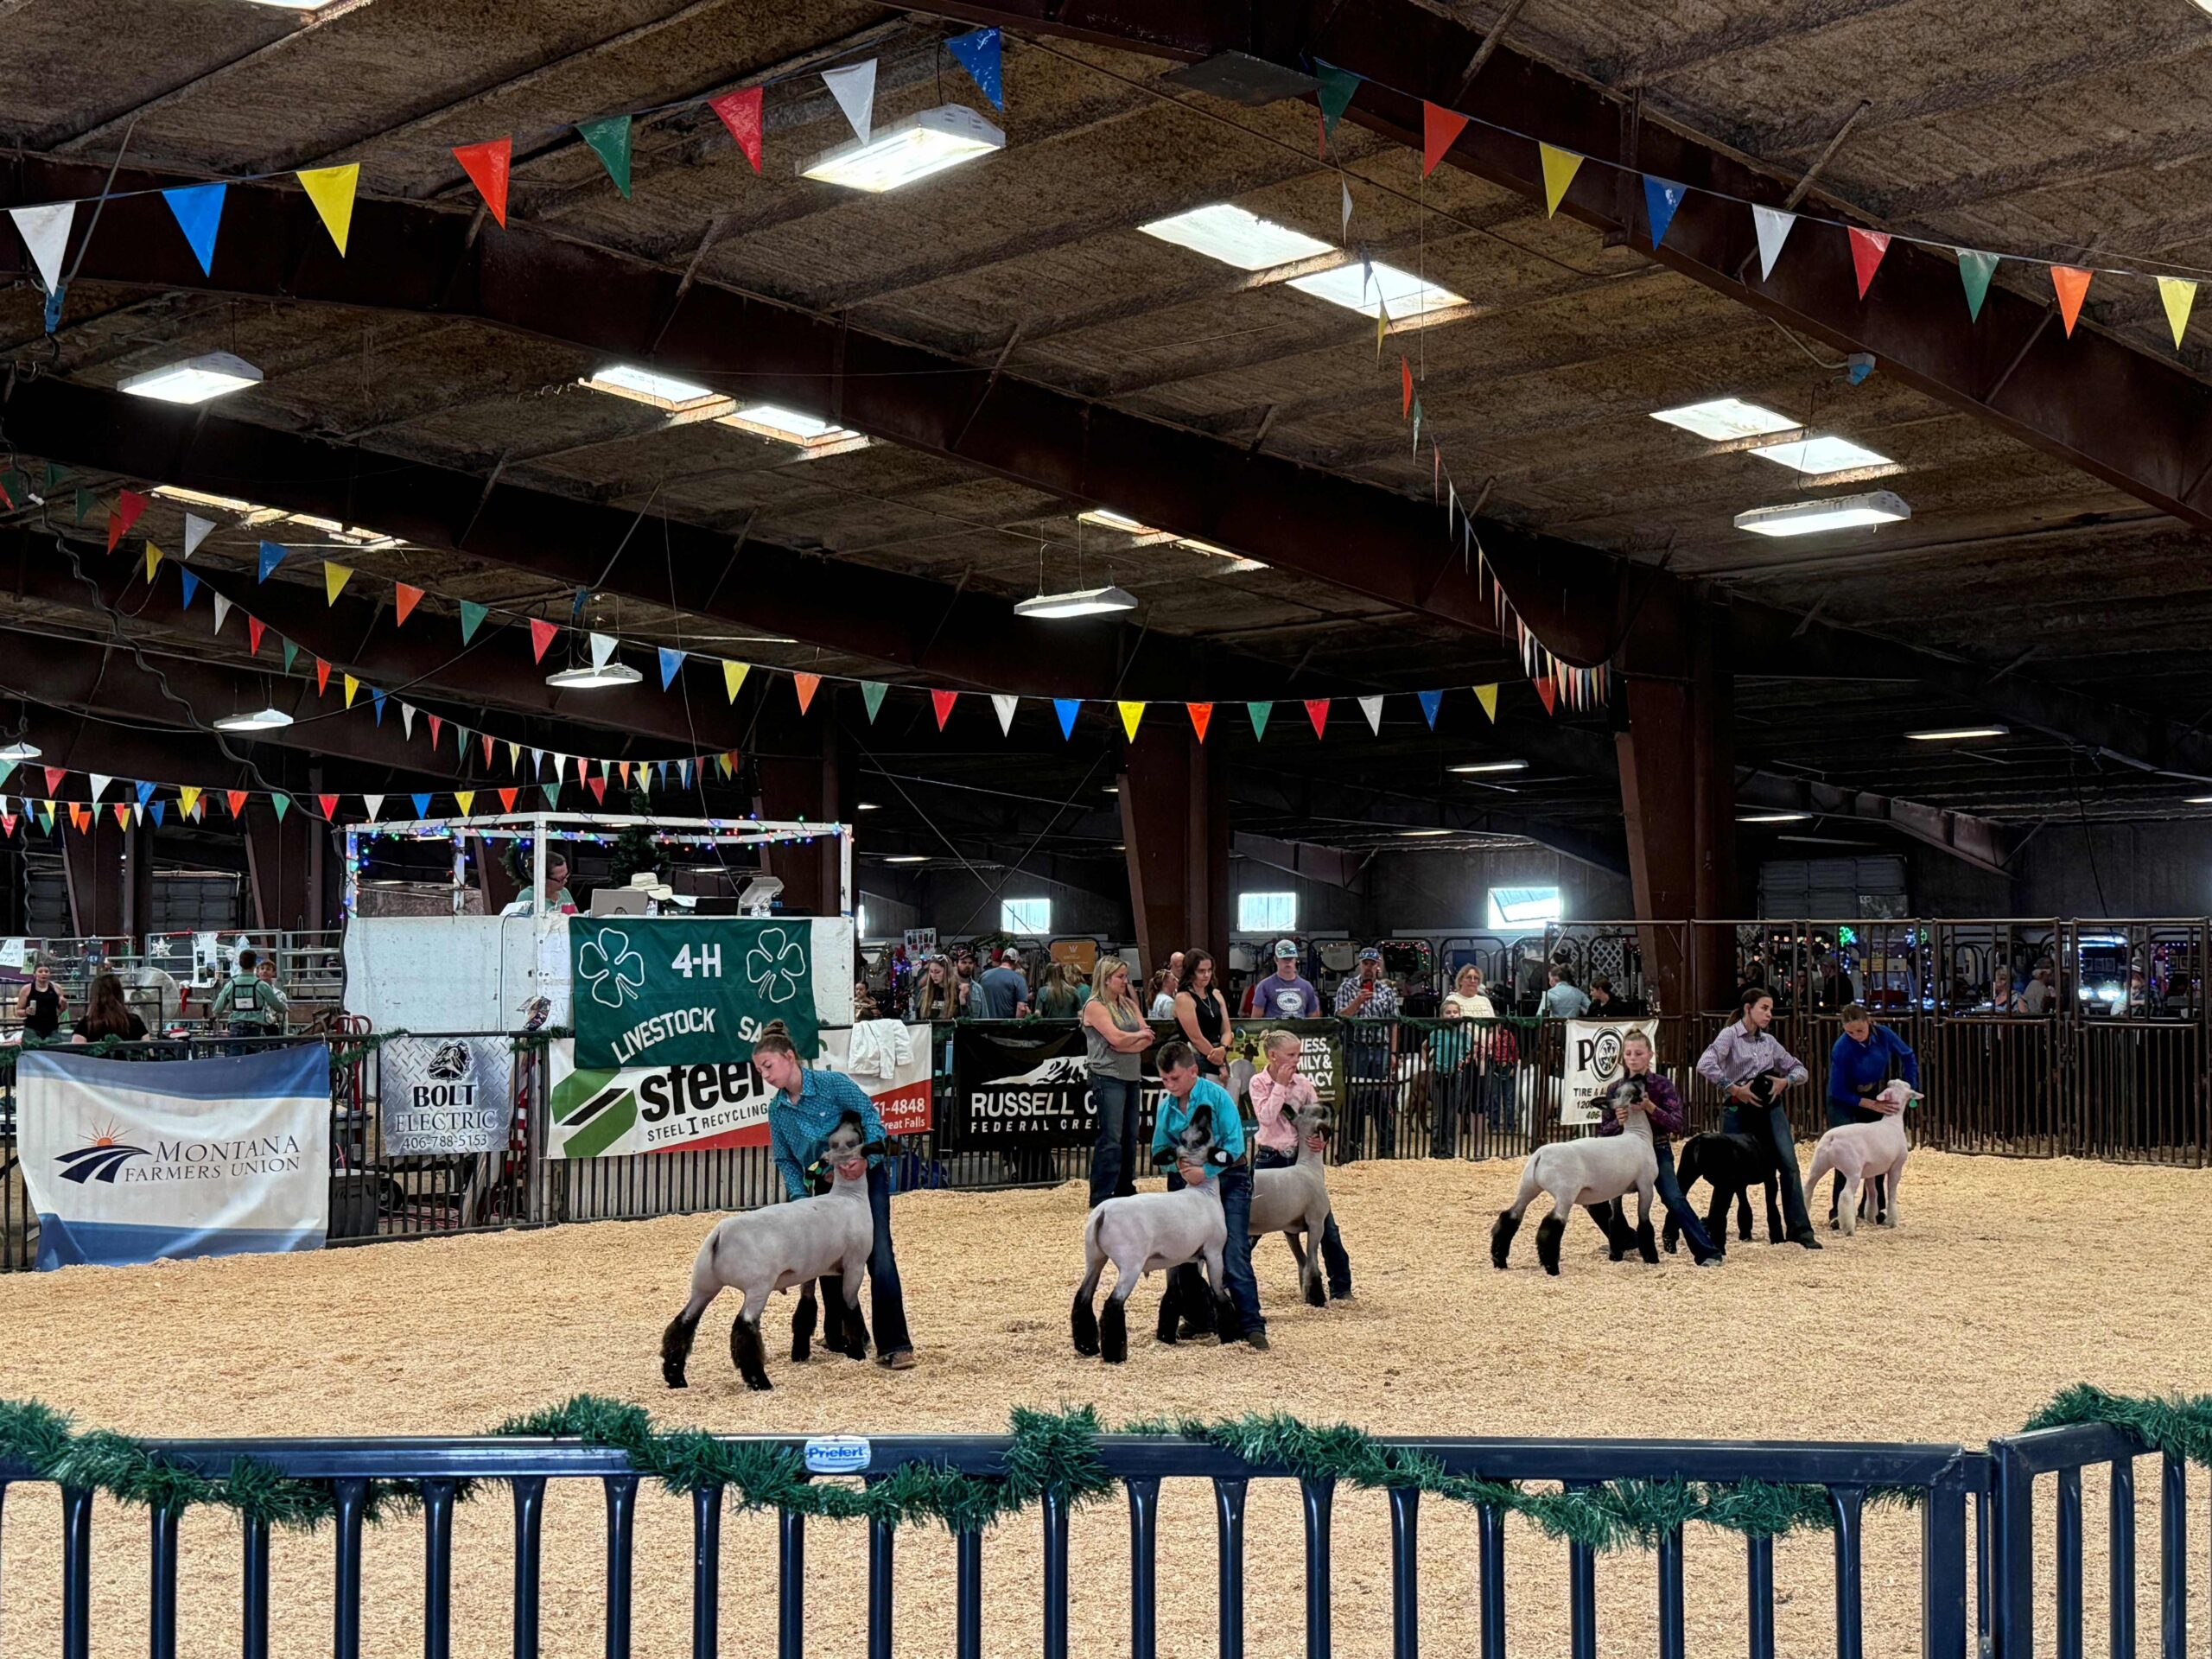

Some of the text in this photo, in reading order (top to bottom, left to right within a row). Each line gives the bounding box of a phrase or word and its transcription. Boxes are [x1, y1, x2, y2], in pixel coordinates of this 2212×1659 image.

[671, 944, 722, 978] 4-H
[611, 1007, 716, 1065] LIVESTOCK
[1323, 1054, 1333, 1070] &
[413, 1084, 477, 1108] BOLT
[971, 1091, 1075, 1117] RUSSELL
[1573, 1087, 1592, 1097] TIRE
[395, 1111, 498, 1133] ELECTRIC
[647, 1123, 685, 1142] STEEL
[702, 1103, 768, 1129] RECYCLING
[904, 1116, 925, 1128] Falls
[971, 1120, 1050, 1134] FEDERAL
[155, 1135, 302, 1163] MONTANA
[403, 1134, 488, 1149] 406-788-5153
[125, 1157, 301, 1183] FARMERS UNION
